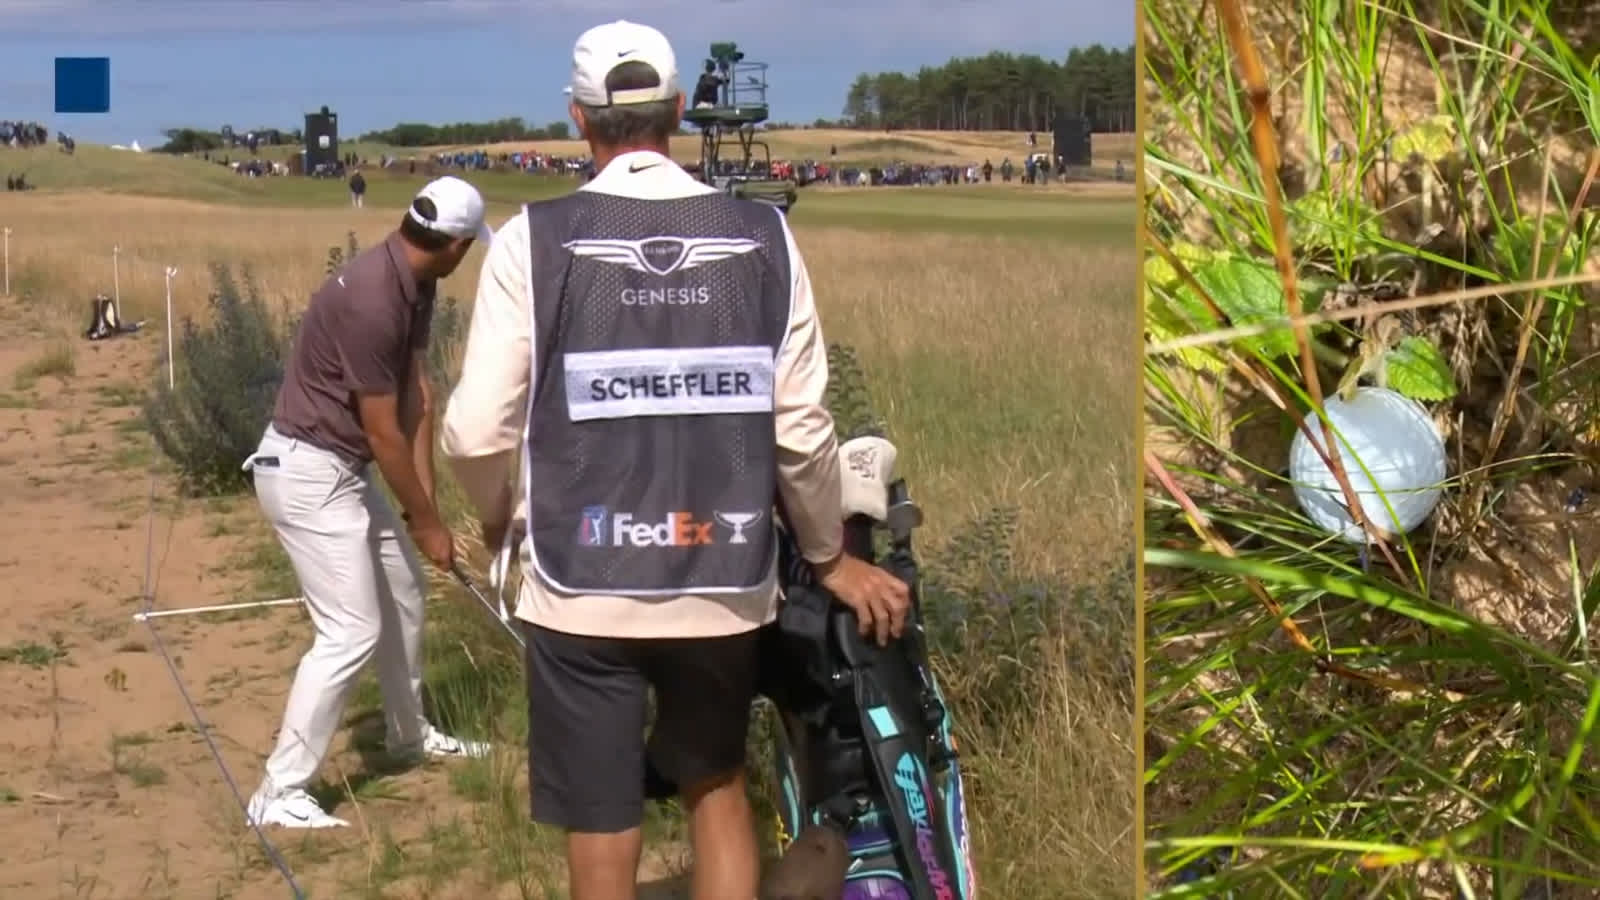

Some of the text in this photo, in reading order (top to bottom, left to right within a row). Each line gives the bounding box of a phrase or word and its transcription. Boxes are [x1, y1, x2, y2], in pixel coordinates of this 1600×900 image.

[620, 286, 710, 306] GENESIS
[590, 372, 753, 402] SCHEFFLER
[612, 510, 715, 547] FedEx
